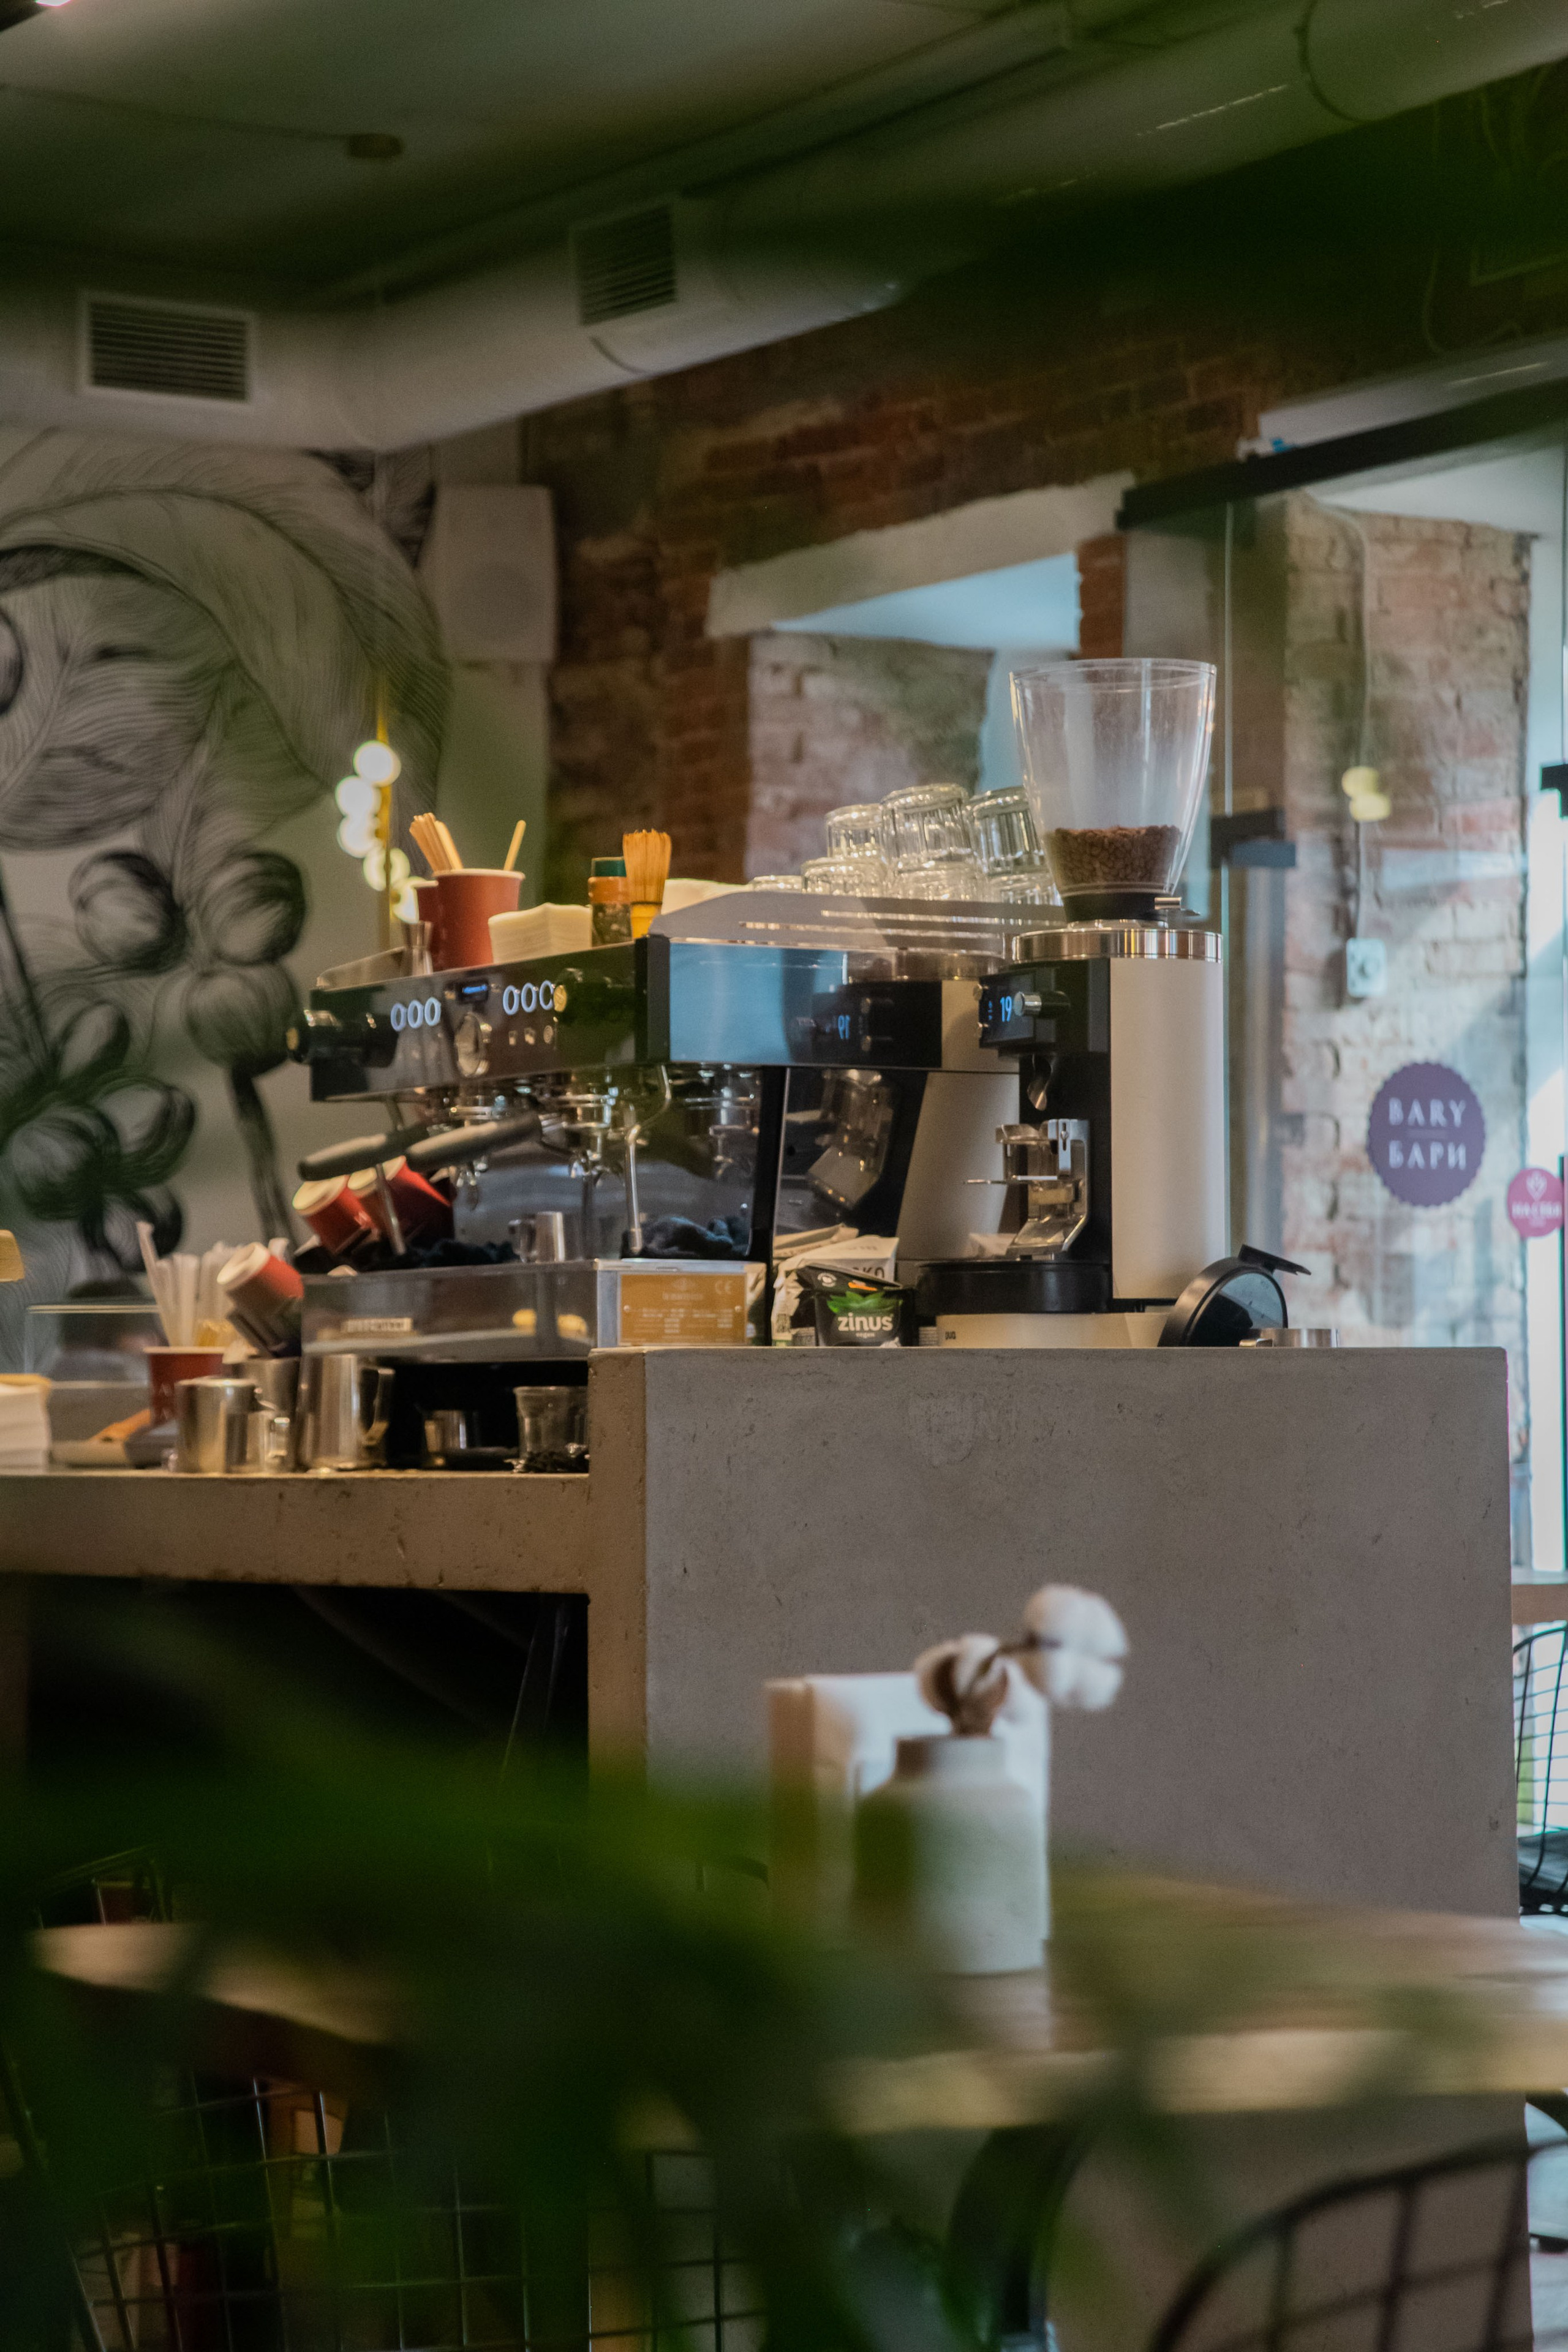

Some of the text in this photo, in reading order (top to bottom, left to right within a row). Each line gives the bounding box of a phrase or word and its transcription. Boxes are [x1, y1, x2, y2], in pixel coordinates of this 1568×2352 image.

[1000, 996, 1012, 1022] 19
[1389, 1097, 1466, 1128] BARY
[838, 1313, 894, 1332] zinus
